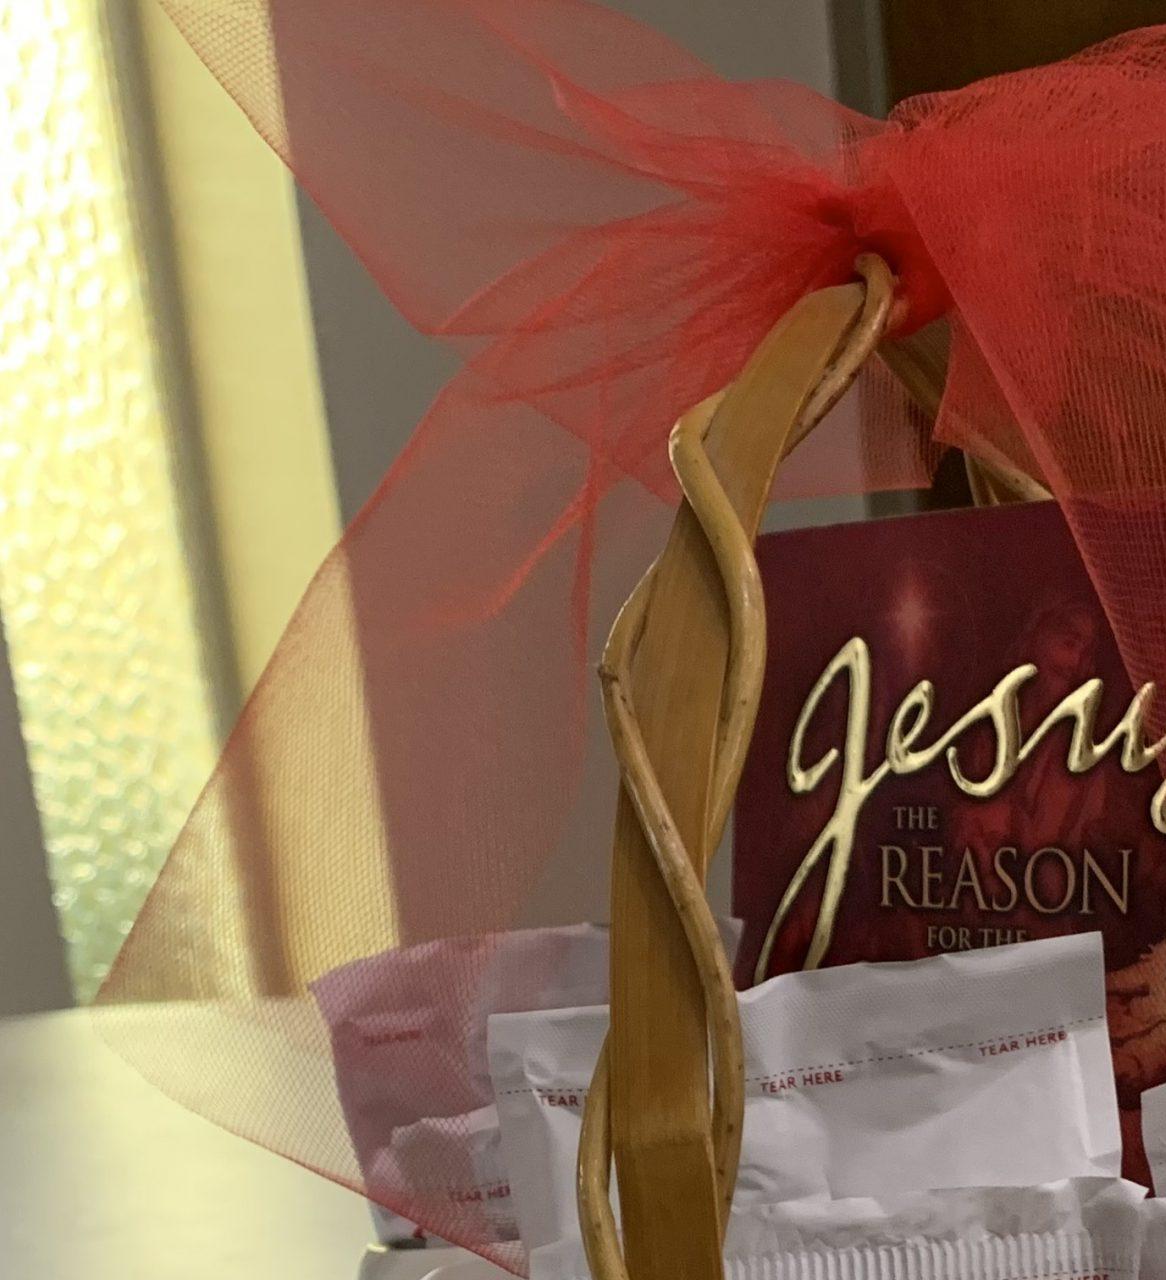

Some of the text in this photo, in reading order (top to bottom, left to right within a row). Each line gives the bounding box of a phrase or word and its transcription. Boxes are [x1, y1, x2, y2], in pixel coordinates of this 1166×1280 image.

[893, 806, 939, 830] THE
[879, 845, 1133, 914] REASON
[927, 926, 971, 949] FOR
[978, 1029, 1068, 1057] TEAR HERE
[760, 1069, 845, 1094] TEAR HERE
[539, 1095, 579, 1107] TEAR
